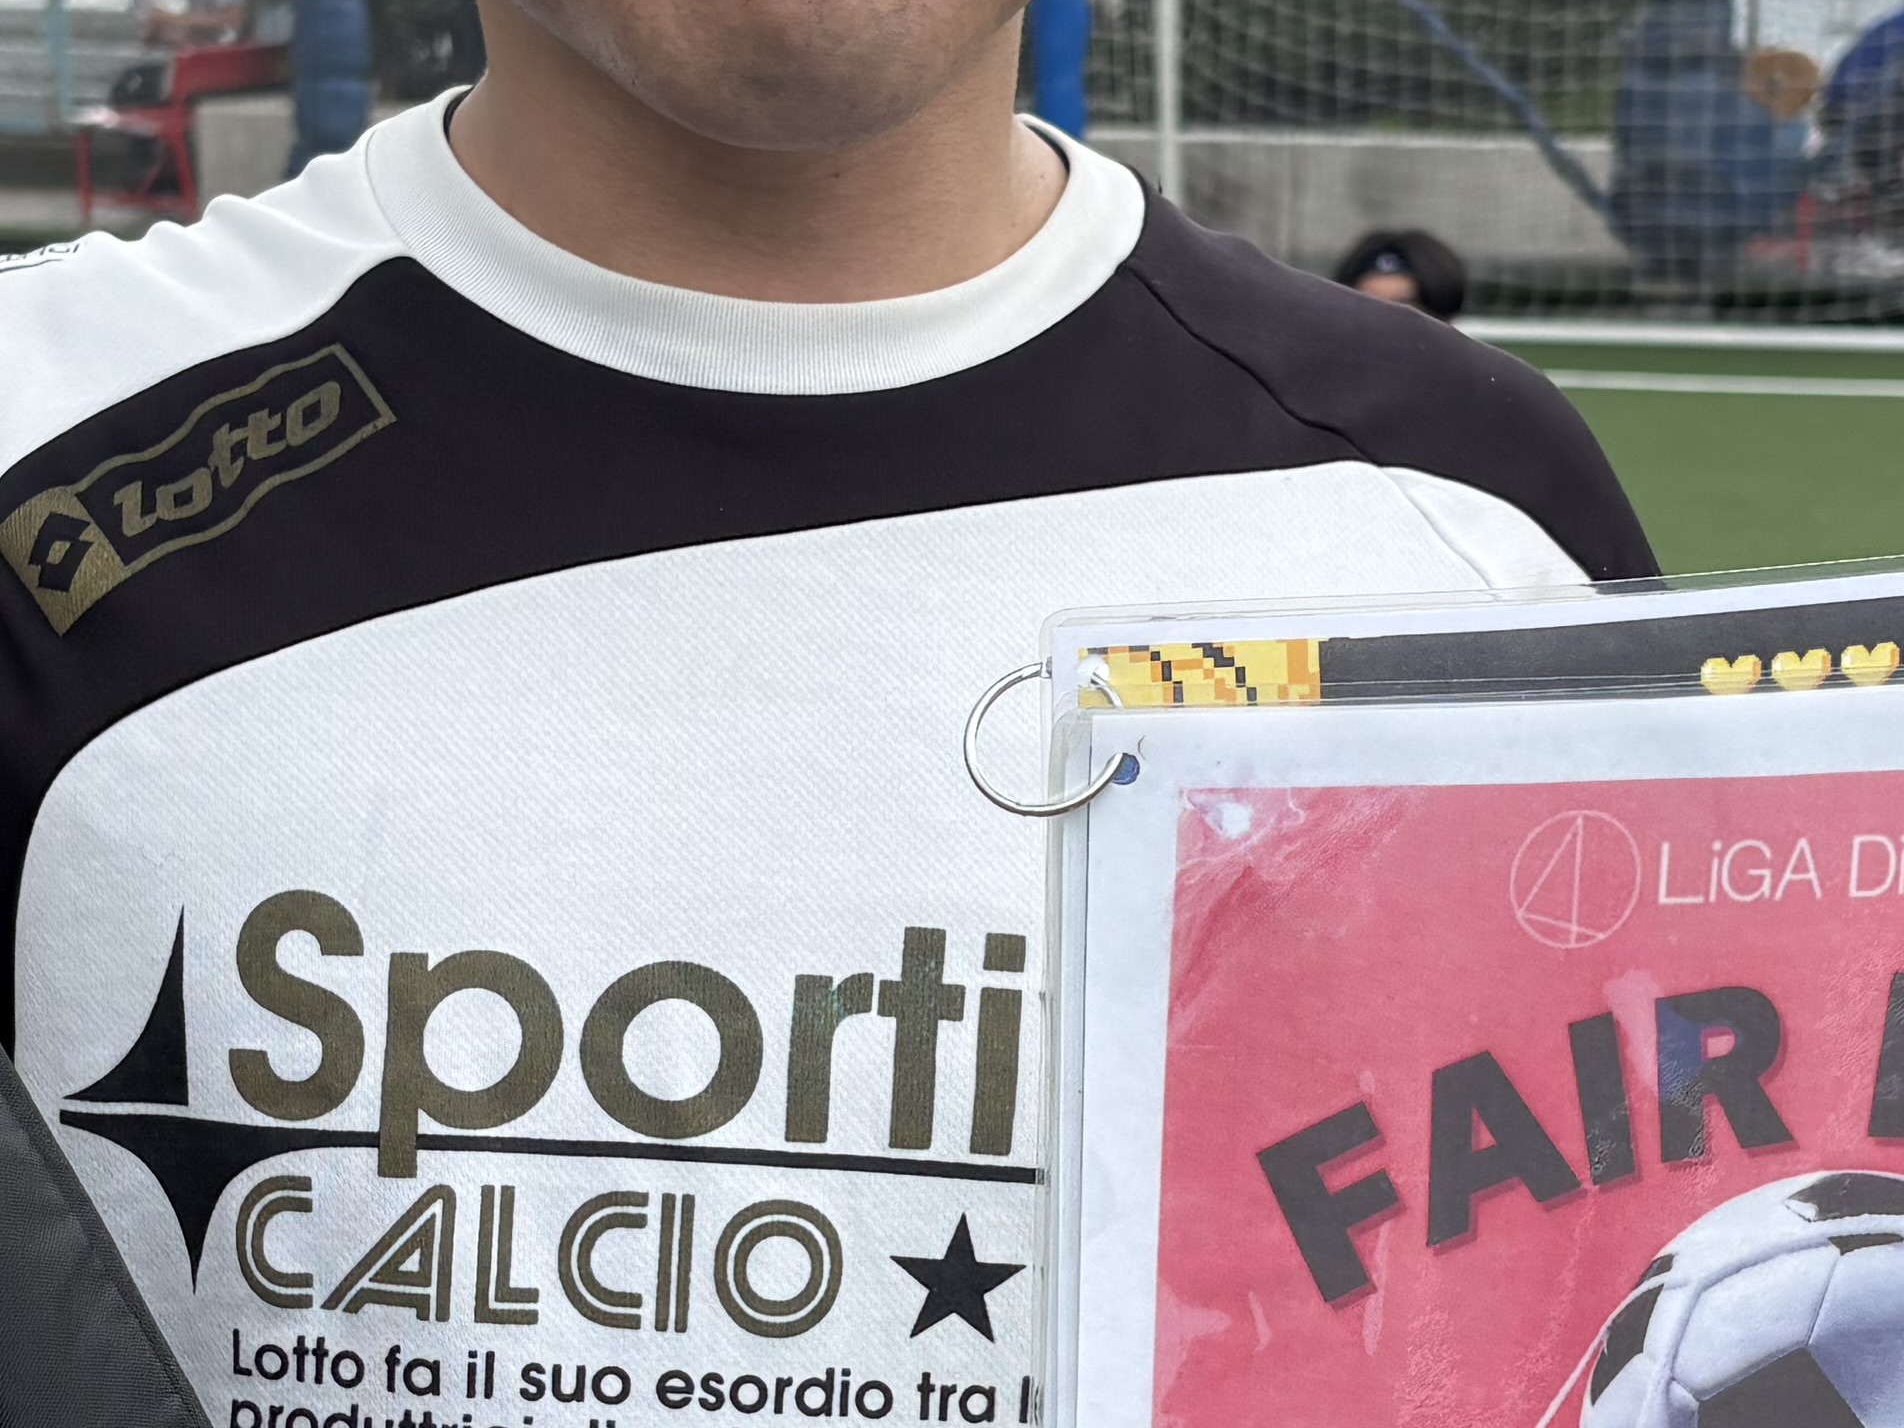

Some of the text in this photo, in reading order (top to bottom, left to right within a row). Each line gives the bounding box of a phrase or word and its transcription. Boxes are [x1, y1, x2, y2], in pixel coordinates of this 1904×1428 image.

[227, 889, 1036, 1178] Sporti
[1255, 985, 1799, 1307] FAIR
[235, 1174, 844, 1338] CALCIO
[232, 1328, 366, 1389] Lotto
[385, 1344, 441, 1397] fa
[466, 1349, 496, 1400] il
[519, 1362, 632, 1406] suo
[655, 1367, 894, 1420] esordio
[916, 1371, 997, 1424] tra
